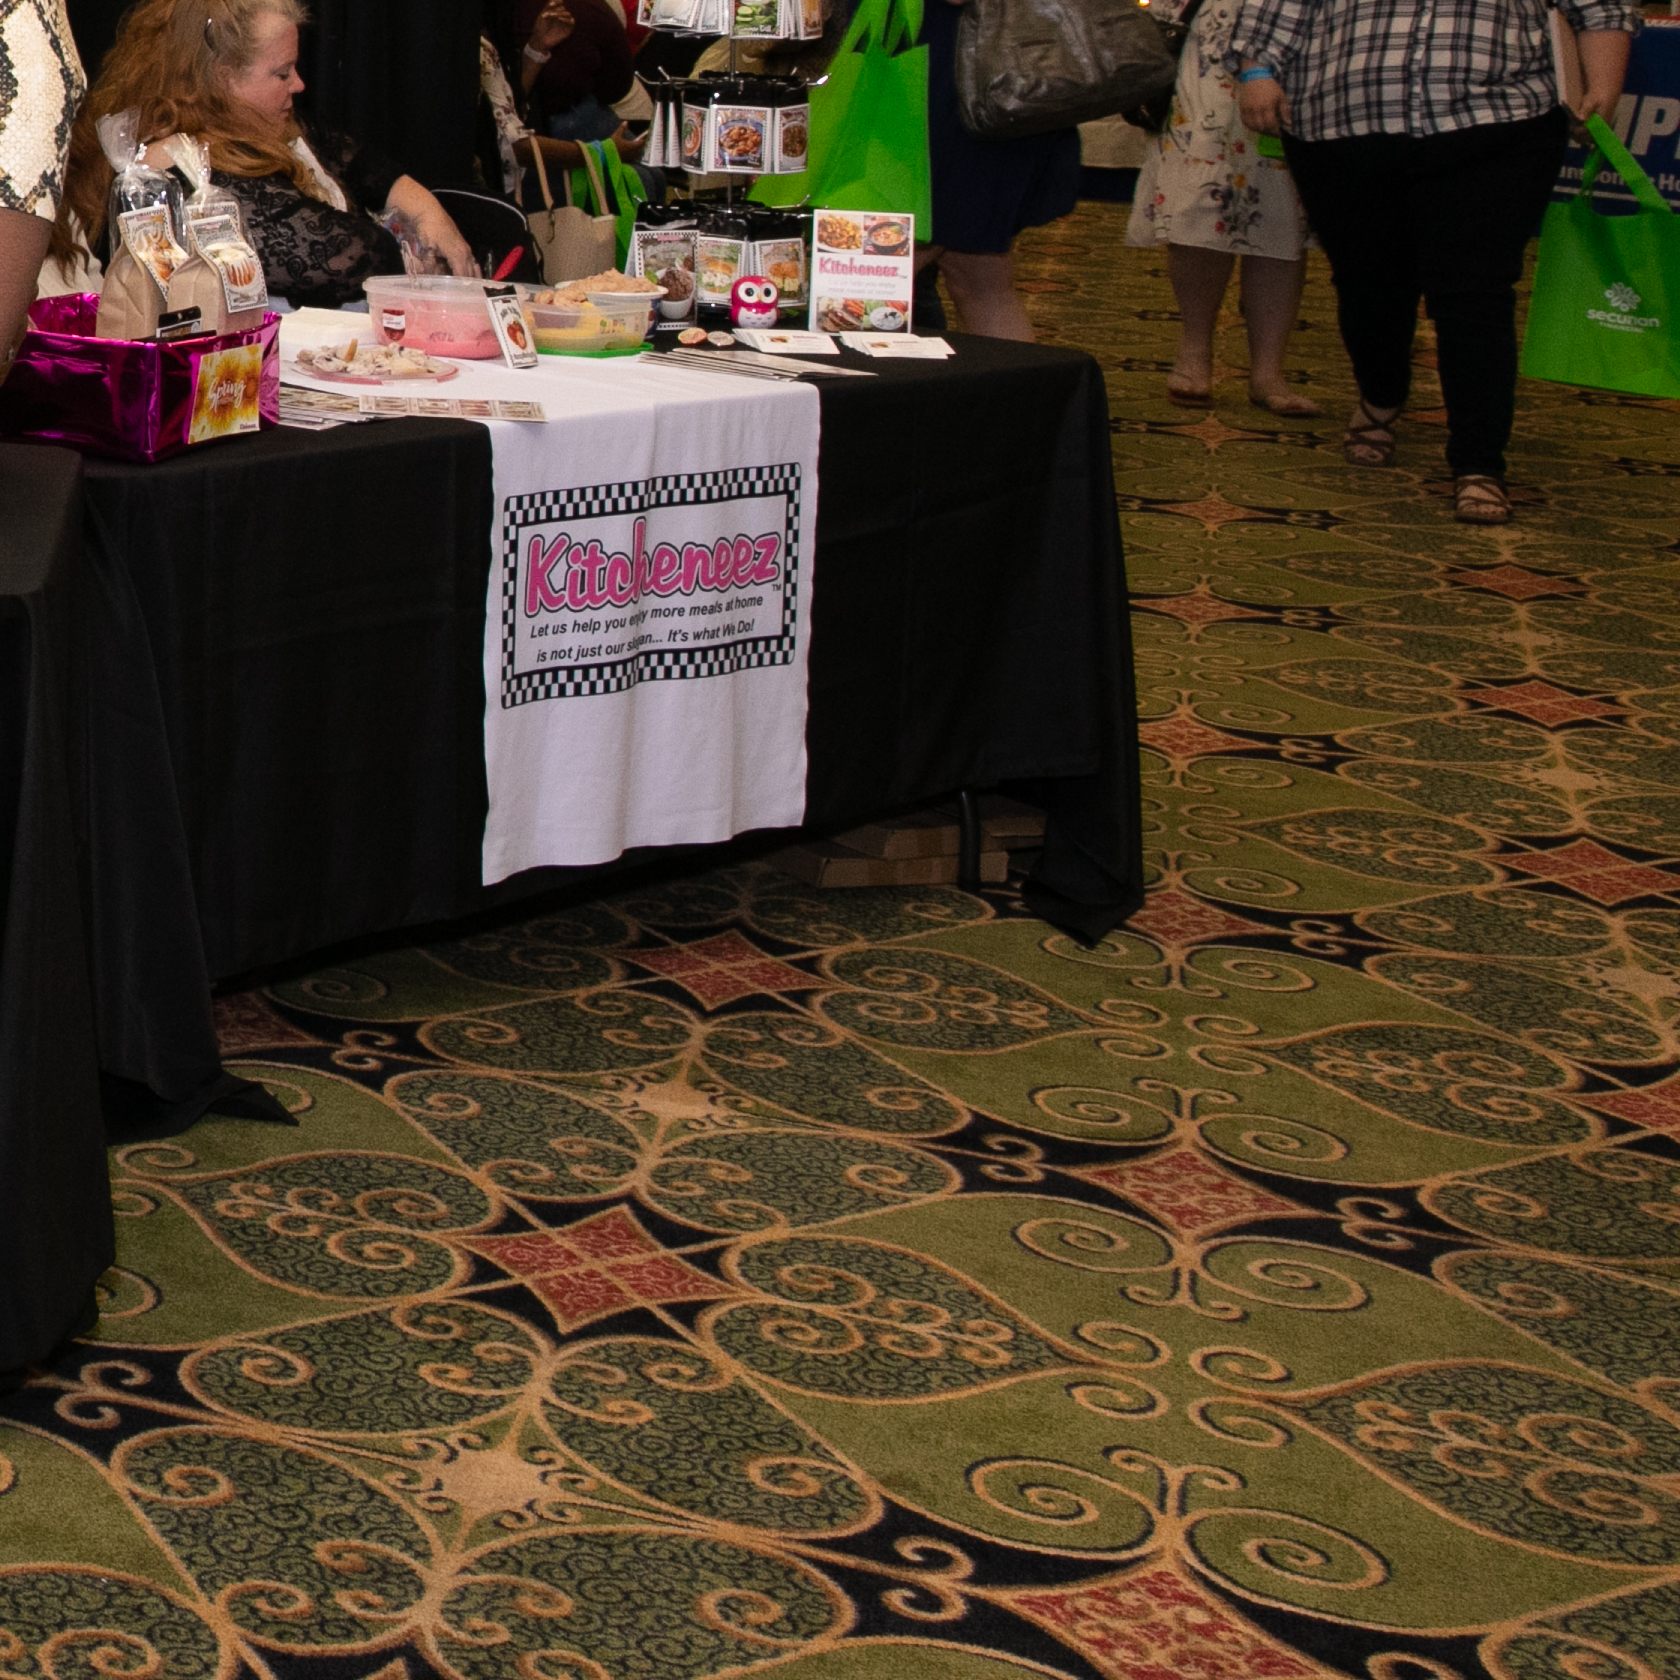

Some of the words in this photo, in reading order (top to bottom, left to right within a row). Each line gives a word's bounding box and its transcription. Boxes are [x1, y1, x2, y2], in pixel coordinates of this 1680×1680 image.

[818, 257, 899, 278] Kitcheneez
[524, 516, 782, 618] Kitcheneez
[530, 623, 549, 639] Let
[551, 623, 567, 635] us
[571, 618, 601, 635] help
[603, 617, 627, 634] you
[650, 606, 685, 619] more
[688, 600, 723, 617] meals
[725, 598, 735, 611] at
[735, 595, 763, 608] home
[536, 648, 548, 663] is
[550, 646, 573, 661] not
[574, 644, 602, 662] just
[605, 642, 626, 656] our
[667, 628, 689, 643] It's
[692, 624, 720, 641] what
[722, 623, 736, 637] We
[737, 618, 755, 634] Do!
